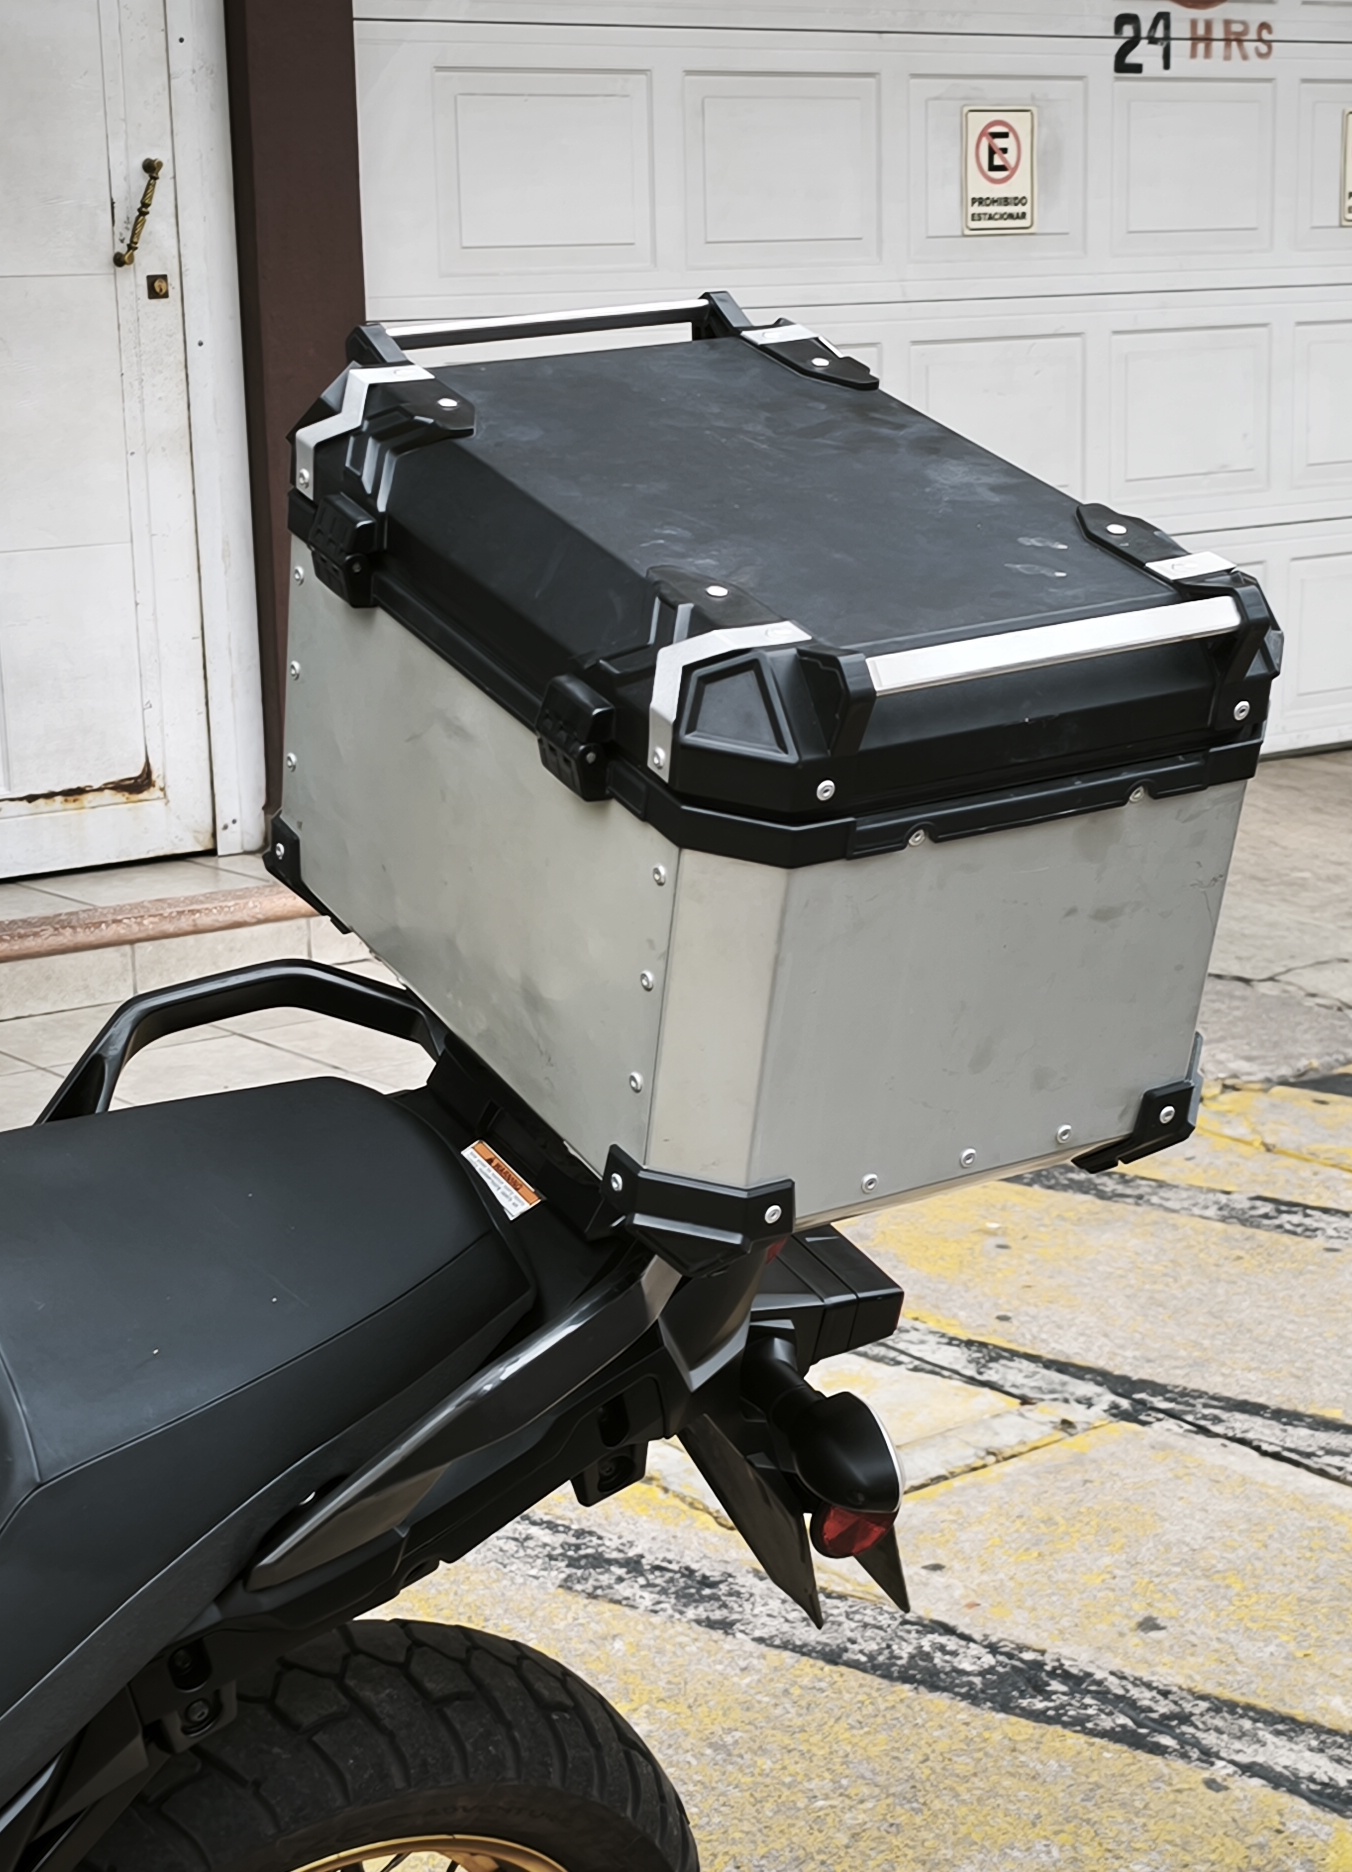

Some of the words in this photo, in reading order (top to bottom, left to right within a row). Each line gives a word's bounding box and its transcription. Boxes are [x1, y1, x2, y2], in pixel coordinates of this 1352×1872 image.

[1114, 11, 1171, 74] 24
[1189, 18, 1273, 61] HRS
[970, 196, 1028, 207] PROHIBIDO
[971, 212, 1027, 221] ESTACIONAR
